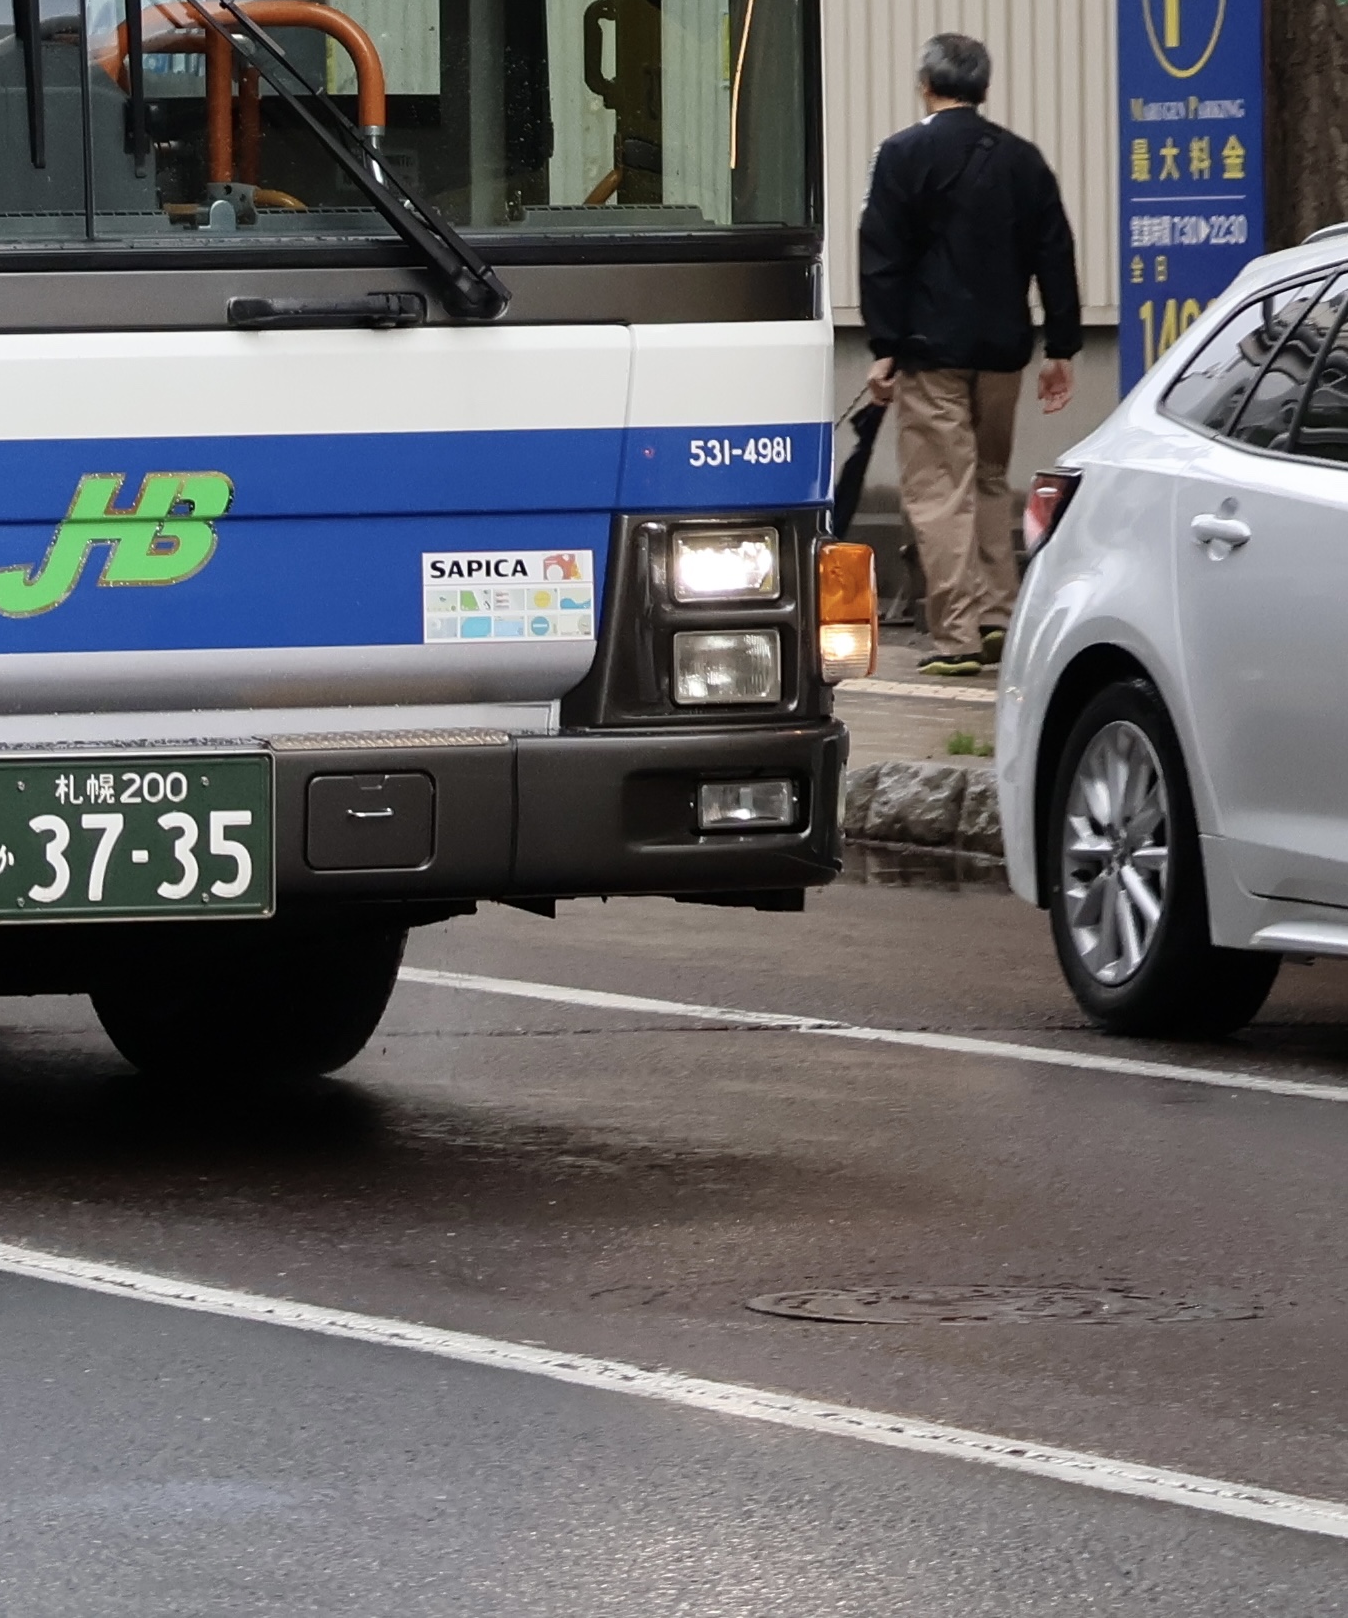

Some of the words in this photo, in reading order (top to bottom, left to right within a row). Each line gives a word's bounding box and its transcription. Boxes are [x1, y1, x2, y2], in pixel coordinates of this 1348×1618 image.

[1131, 134, 1247, 182] 最大料金
[689, 436, 792, 467] 531-4981
[430, 558, 529, 579] SAPICA
[28, 809, 253, 903] 37-35
